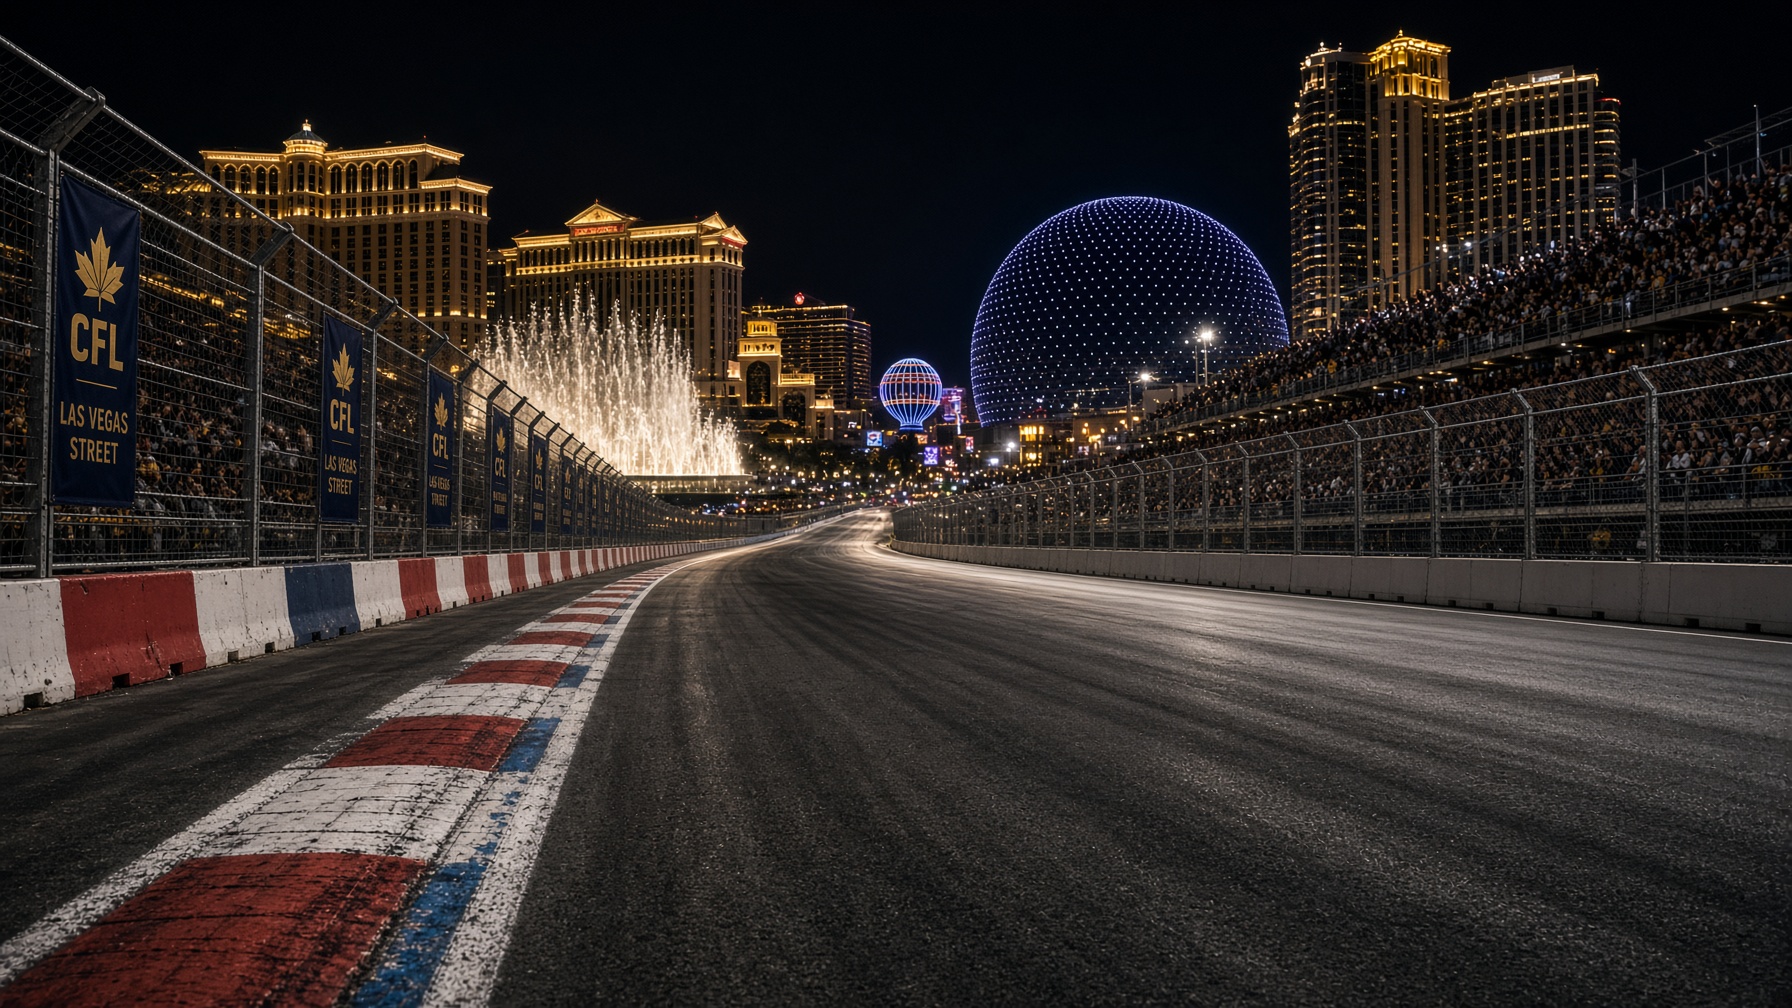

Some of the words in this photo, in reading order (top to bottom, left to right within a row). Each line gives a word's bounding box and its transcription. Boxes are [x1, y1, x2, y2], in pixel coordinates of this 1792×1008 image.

[70, 312, 124, 372] CFL
[60, 401, 85, 428] LAS
[88, 406, 129, 434] VEGAS
[329, 398, 355, 435] CFL
[69, 436, 119, 465] STREET
[432, 432, 449, 460] CFL
[324, 453, 337, 471] LAS
[338, 457, 357, 475] VEGAS
[328, 476, 353, 495] STREET
